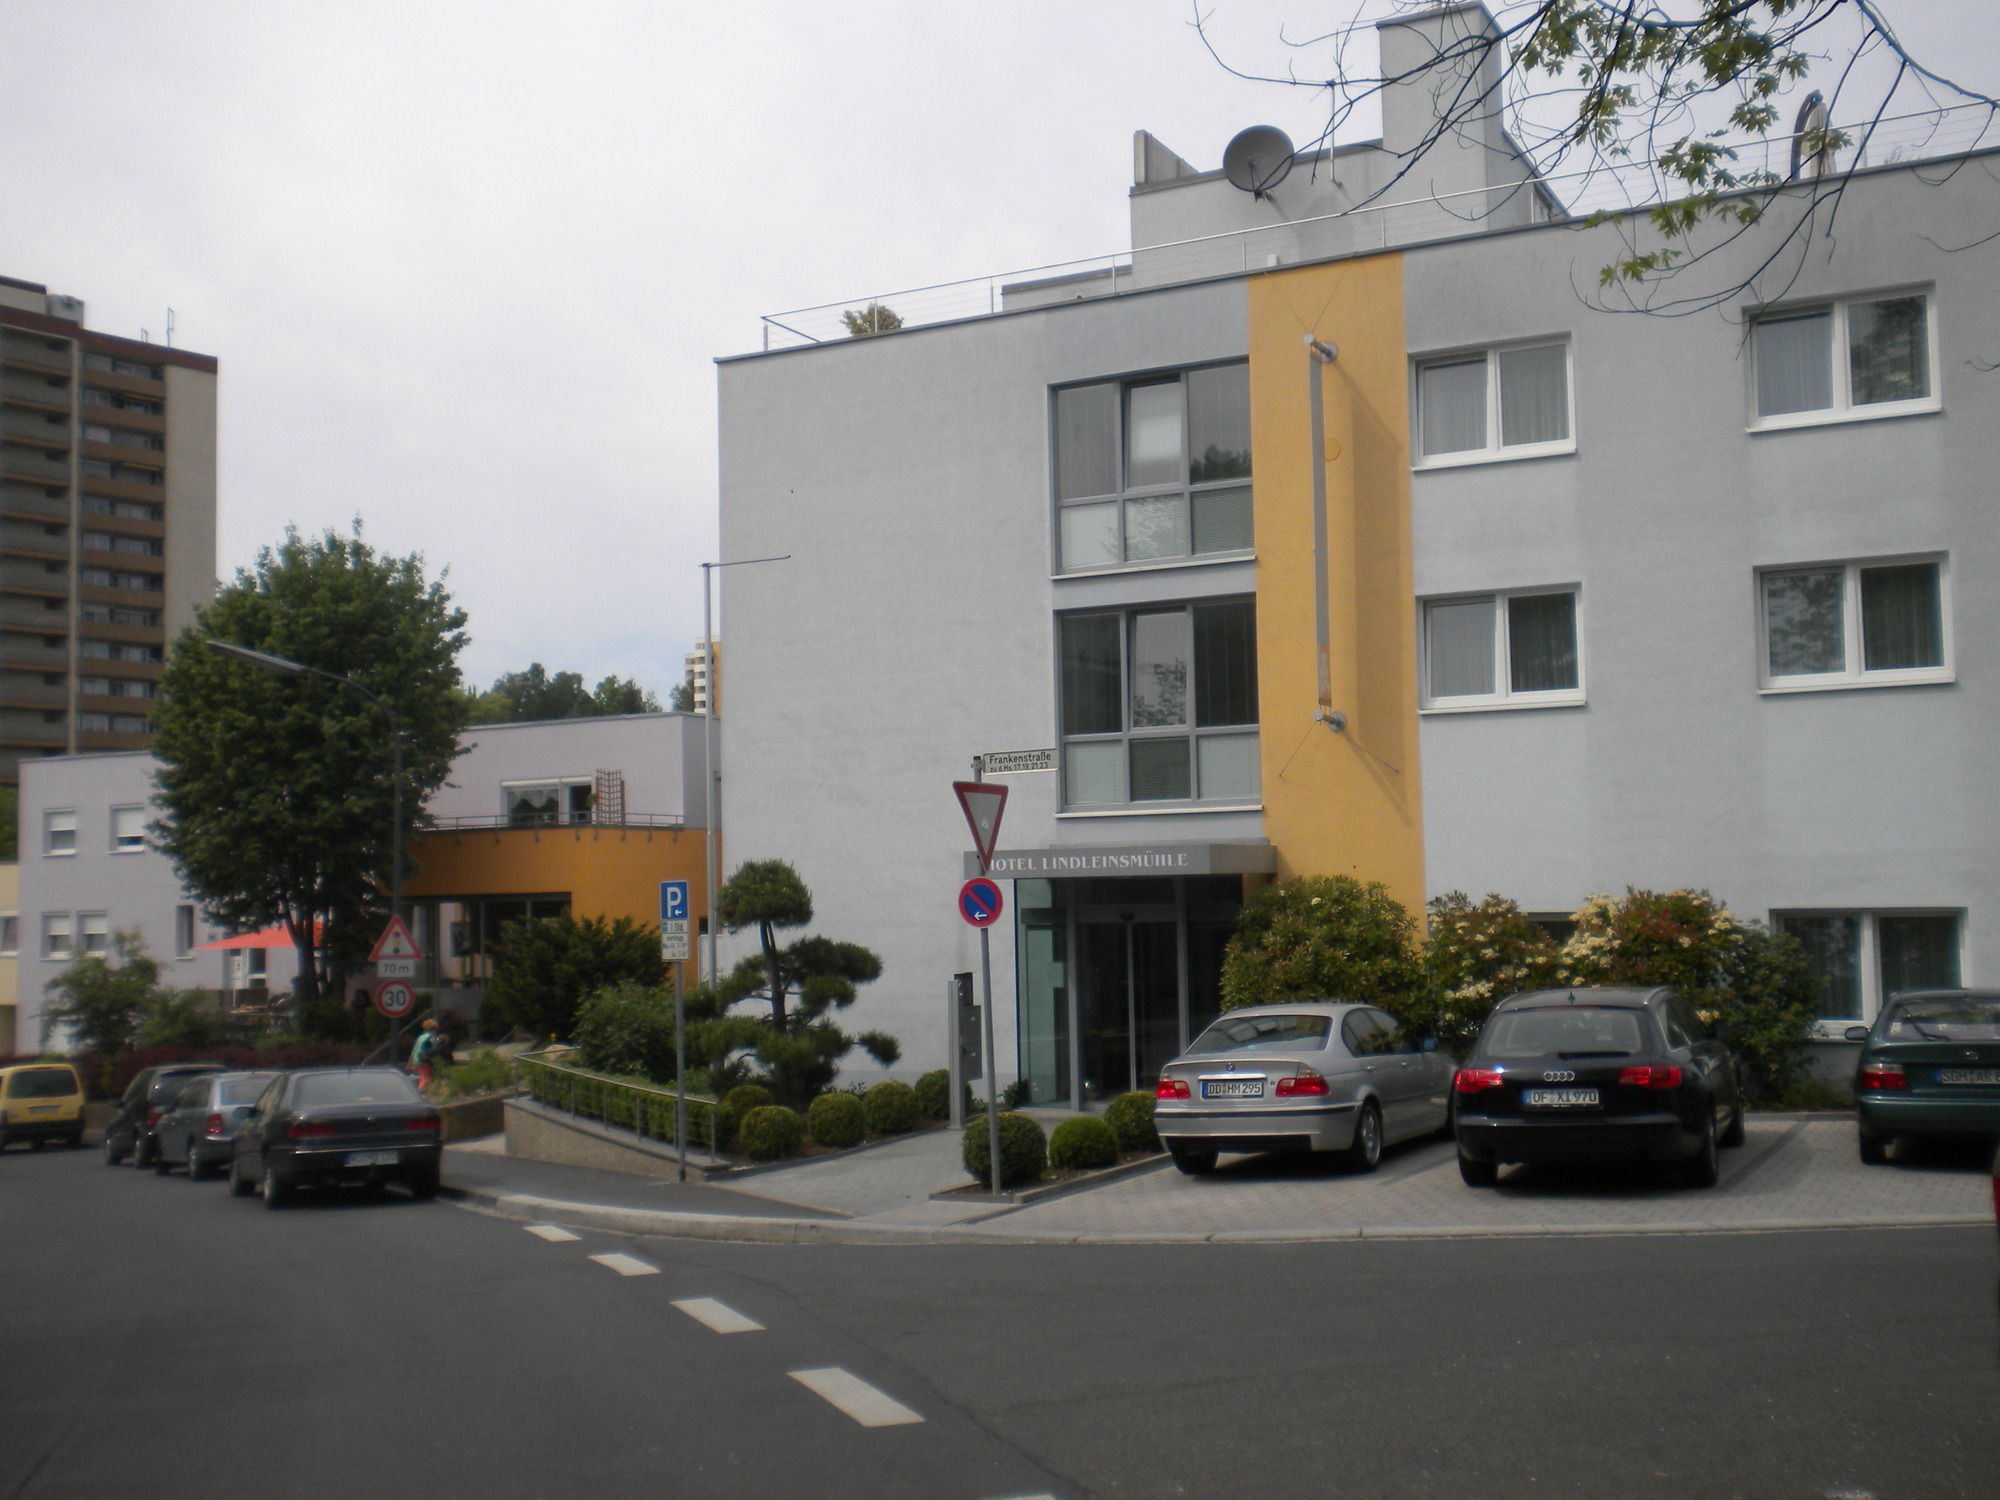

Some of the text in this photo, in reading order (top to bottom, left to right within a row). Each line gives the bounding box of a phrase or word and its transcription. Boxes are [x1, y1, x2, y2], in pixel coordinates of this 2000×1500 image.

[989, 751, 1051, 765] Frankenstraße
[1042, 850, 1189, 871] LINDLEINSMÜHLE
[666, 887, 682, 918] P
[383, 962, 396, 974] 70
[384, 990, 406, 1007] 30
[1208, 1083, 1222, 1095] DD
[1242, 1082, 1261, 1094] 295
[1532, 1091, 1548, 1103] OF
